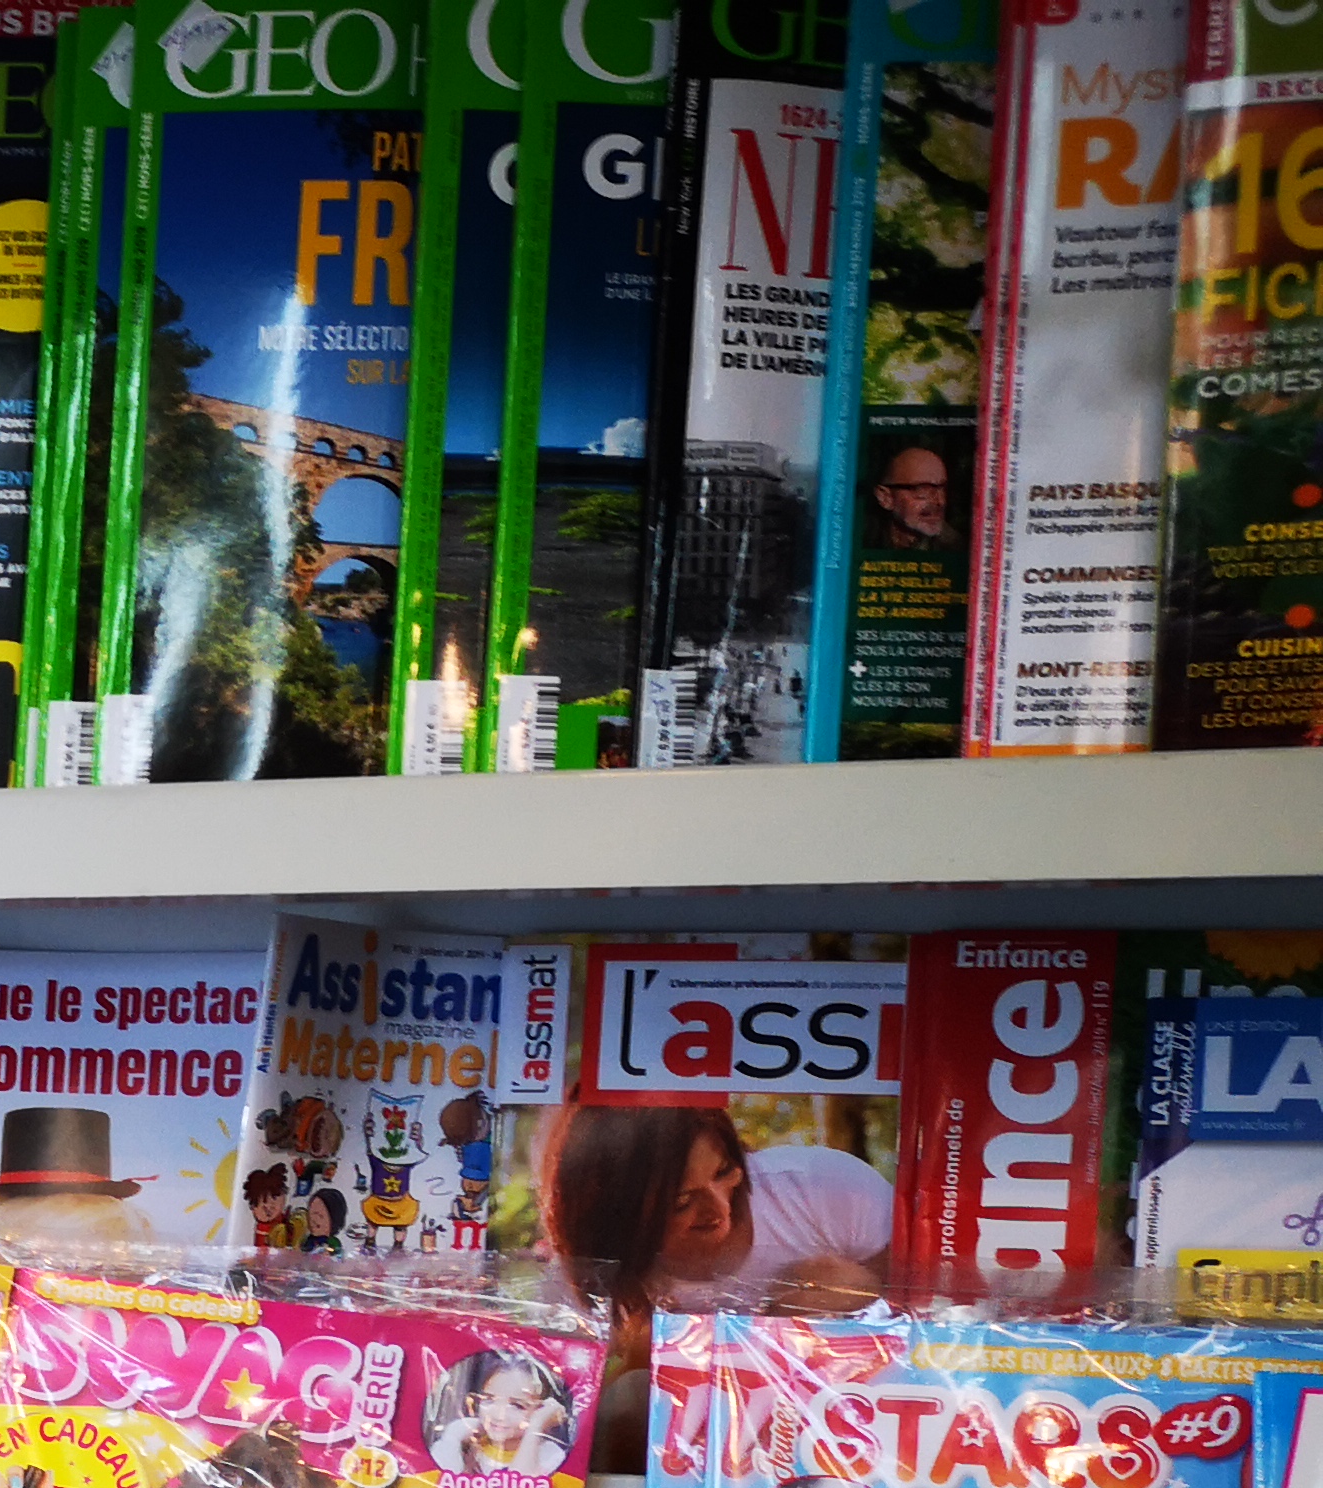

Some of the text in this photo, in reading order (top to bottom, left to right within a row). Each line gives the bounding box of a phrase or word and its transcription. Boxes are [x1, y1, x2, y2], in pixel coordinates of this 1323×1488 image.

[161, 8, 398, 101] GEO
[726, 283, 757, 301] LES
[724, 306, 797, 330] HEURES
[723, 329, 812, 353] LA VILLE
[955, 939, 1088, 971] Enfance
[47, 980, 79, 1024] le
